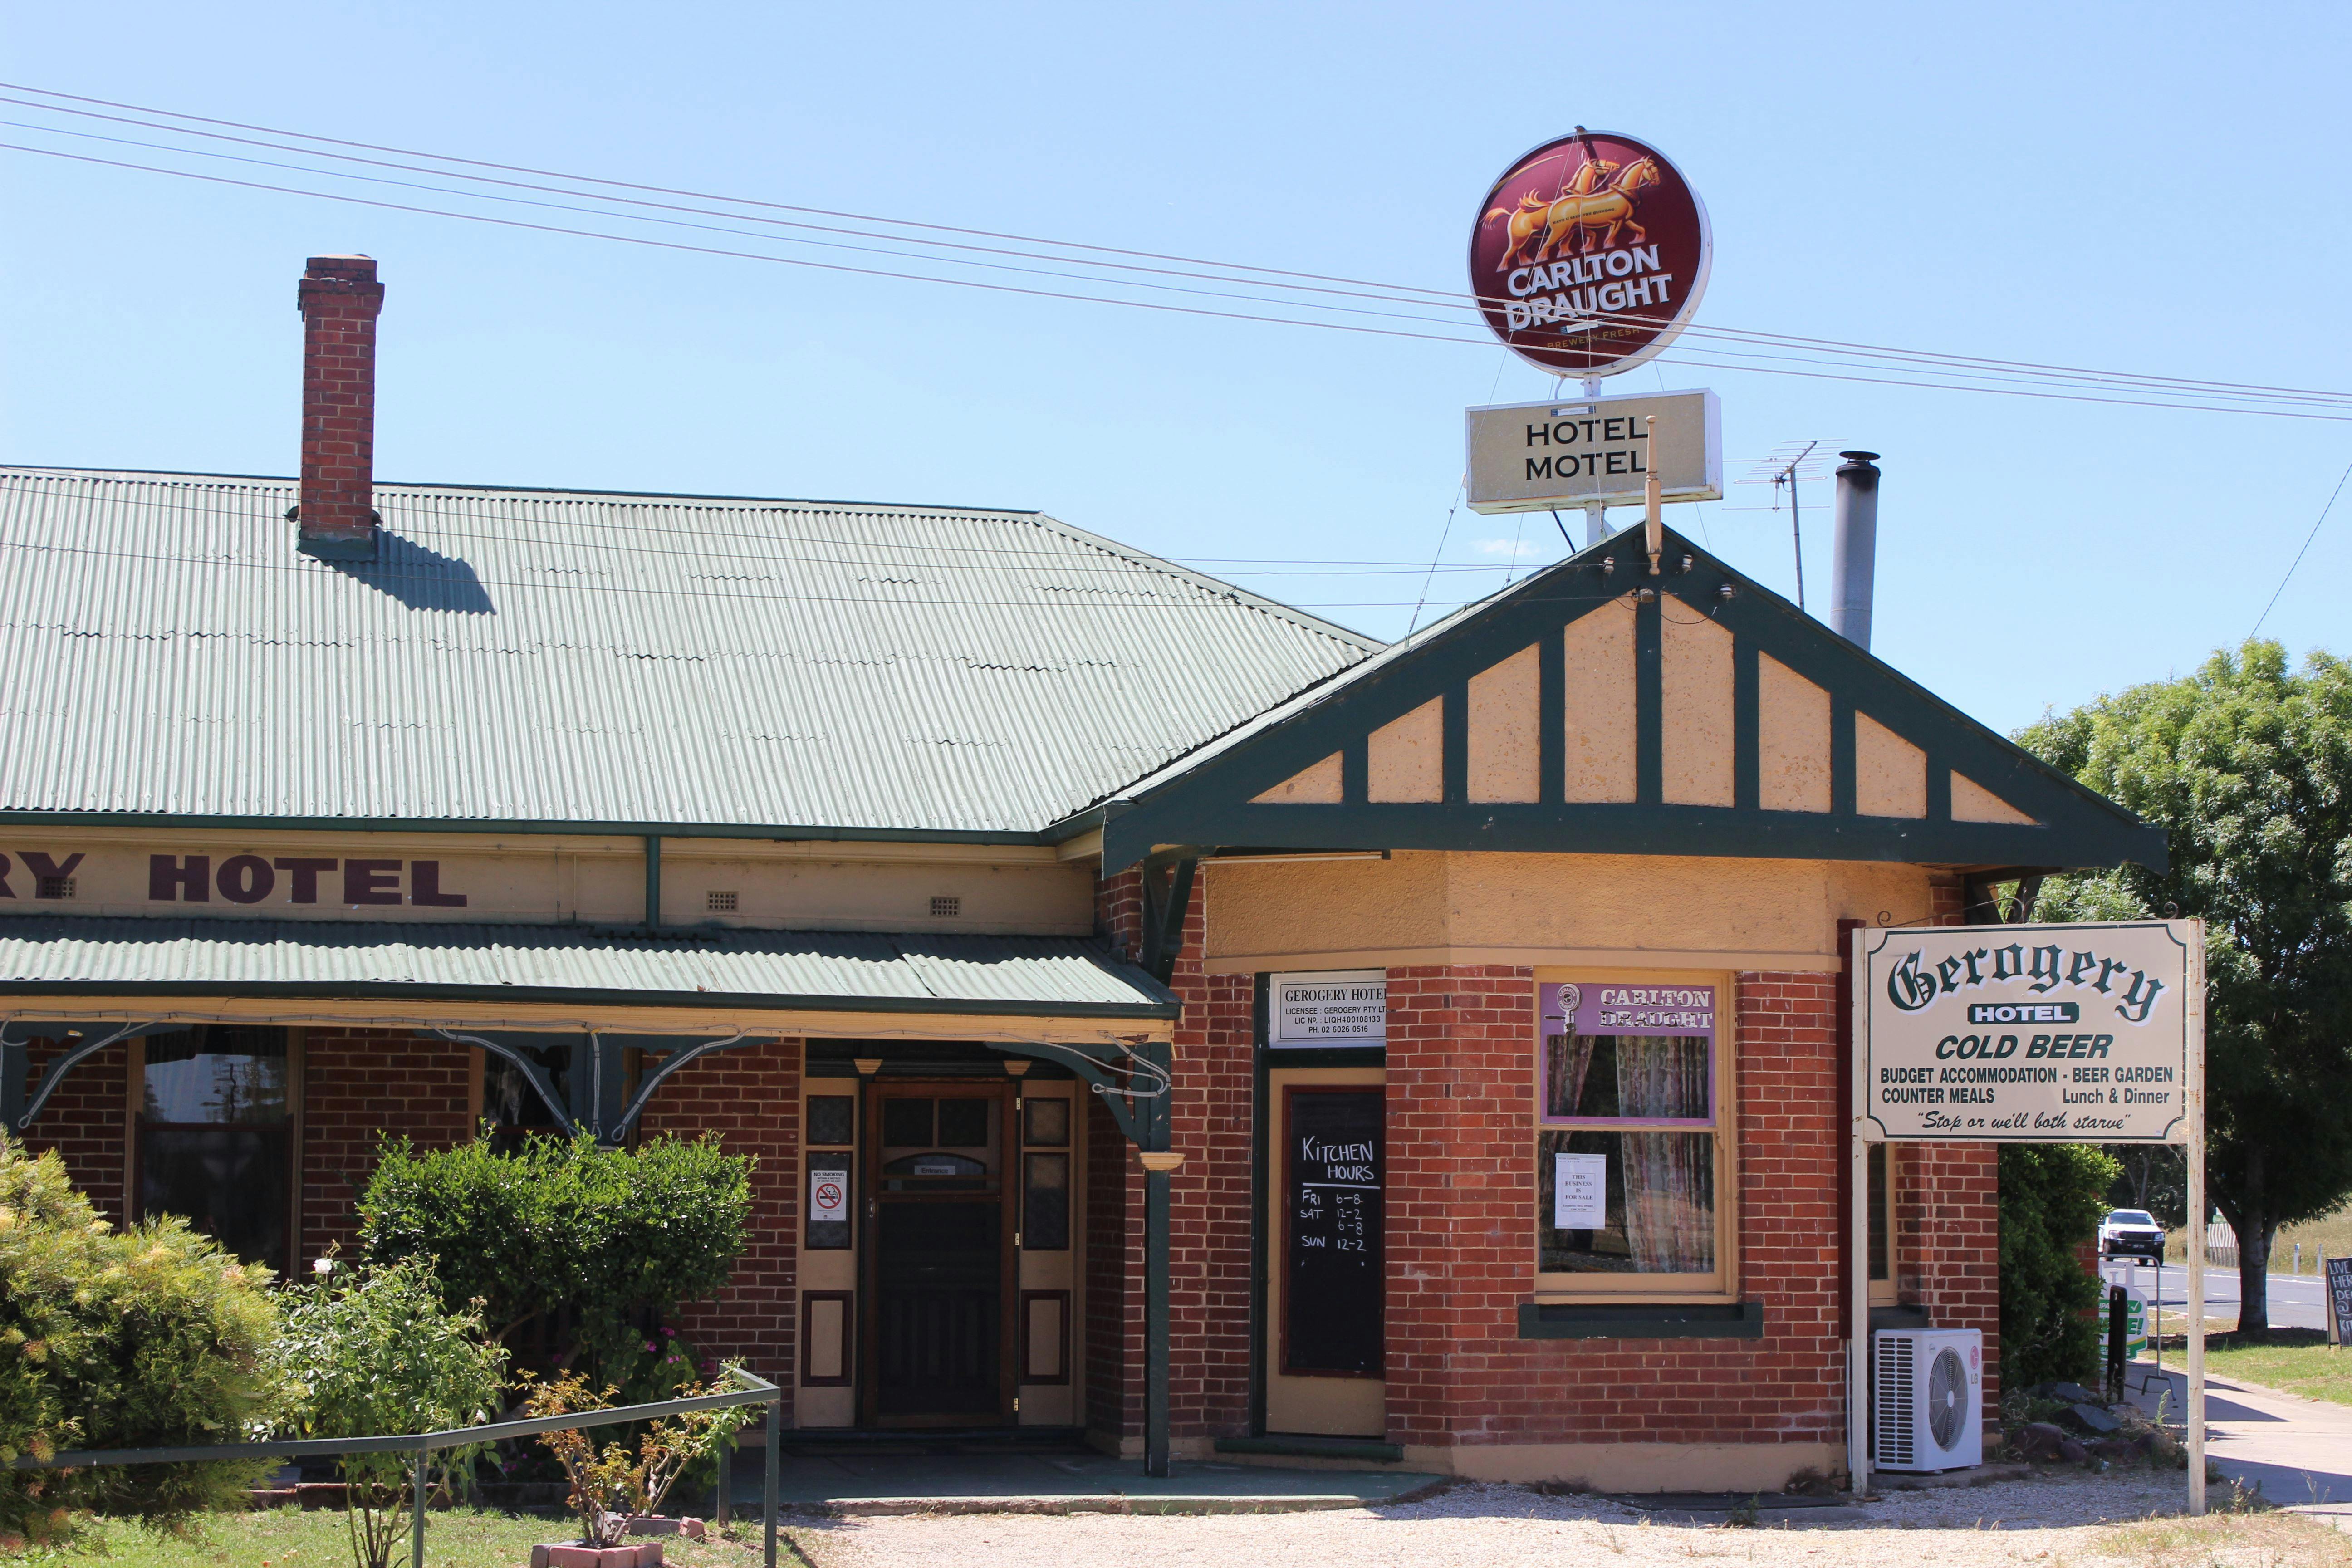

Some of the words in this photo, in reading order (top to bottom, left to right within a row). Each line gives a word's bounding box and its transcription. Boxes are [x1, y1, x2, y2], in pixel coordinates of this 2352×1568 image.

[1507, 244, 1662, 298] CARLTON
[1503, 274, 1673, 333] DRAUGHT
[1547, 334, 1599, 348] BREWERY
[1602, 328, 1640, 339] FRESH
[1526, 417, 1648, 447] HOTEL
[1525, 450, 1647, 480] MOTEL
[149, 854, 467, 907] HOTEL
[1559, 988, 1576, 996] CARLTON
[1887, 943, 2167, 1024] Gerogery
[1285, 989, 1348, 1002] GEROGERY
[1559, 1000, 1576, 1008] DRAUGHT
[1600, 989, 1711, 1007] CARLTON
[1599, 1011, 1713, 1028] DRAUGHT
[1975, 1005, 2071, 1022] HOTEL
[1936, 1034, 2018, 1059] COLD
[2025, 1034, 2113, 1059] BEER
[1881, 1068, 1934, 1083] BUDGET
[1939, 1067, 2057, 1083] ACCOMMODATION
[2073, 1067, 2109, 1083] BEER
[2114, 1067, 2173, 1083] GARDEN
[1882, 1088, 1944, 1104] COUNTER
[1950, 1088, 1994, 1104] MEALS
[2063, 1088, 2103, 1104] Lunch
[2109, 1088, 2118, 1104] &
[2124, 1088, 2170, 1104] Dinner
[1967, 1117, 1985, 1128] or
[2034, 1111, 2067, 1129] both
[1328, 1165, 1374, 1181] HOURS
[1302, 1189, 1320, 1205] FRI
[1300, 1209, 1324, 1220] SAT
[1301, 1235, 1326, 1248] SUN
[1971, 1373, 1978, 1384] LG
